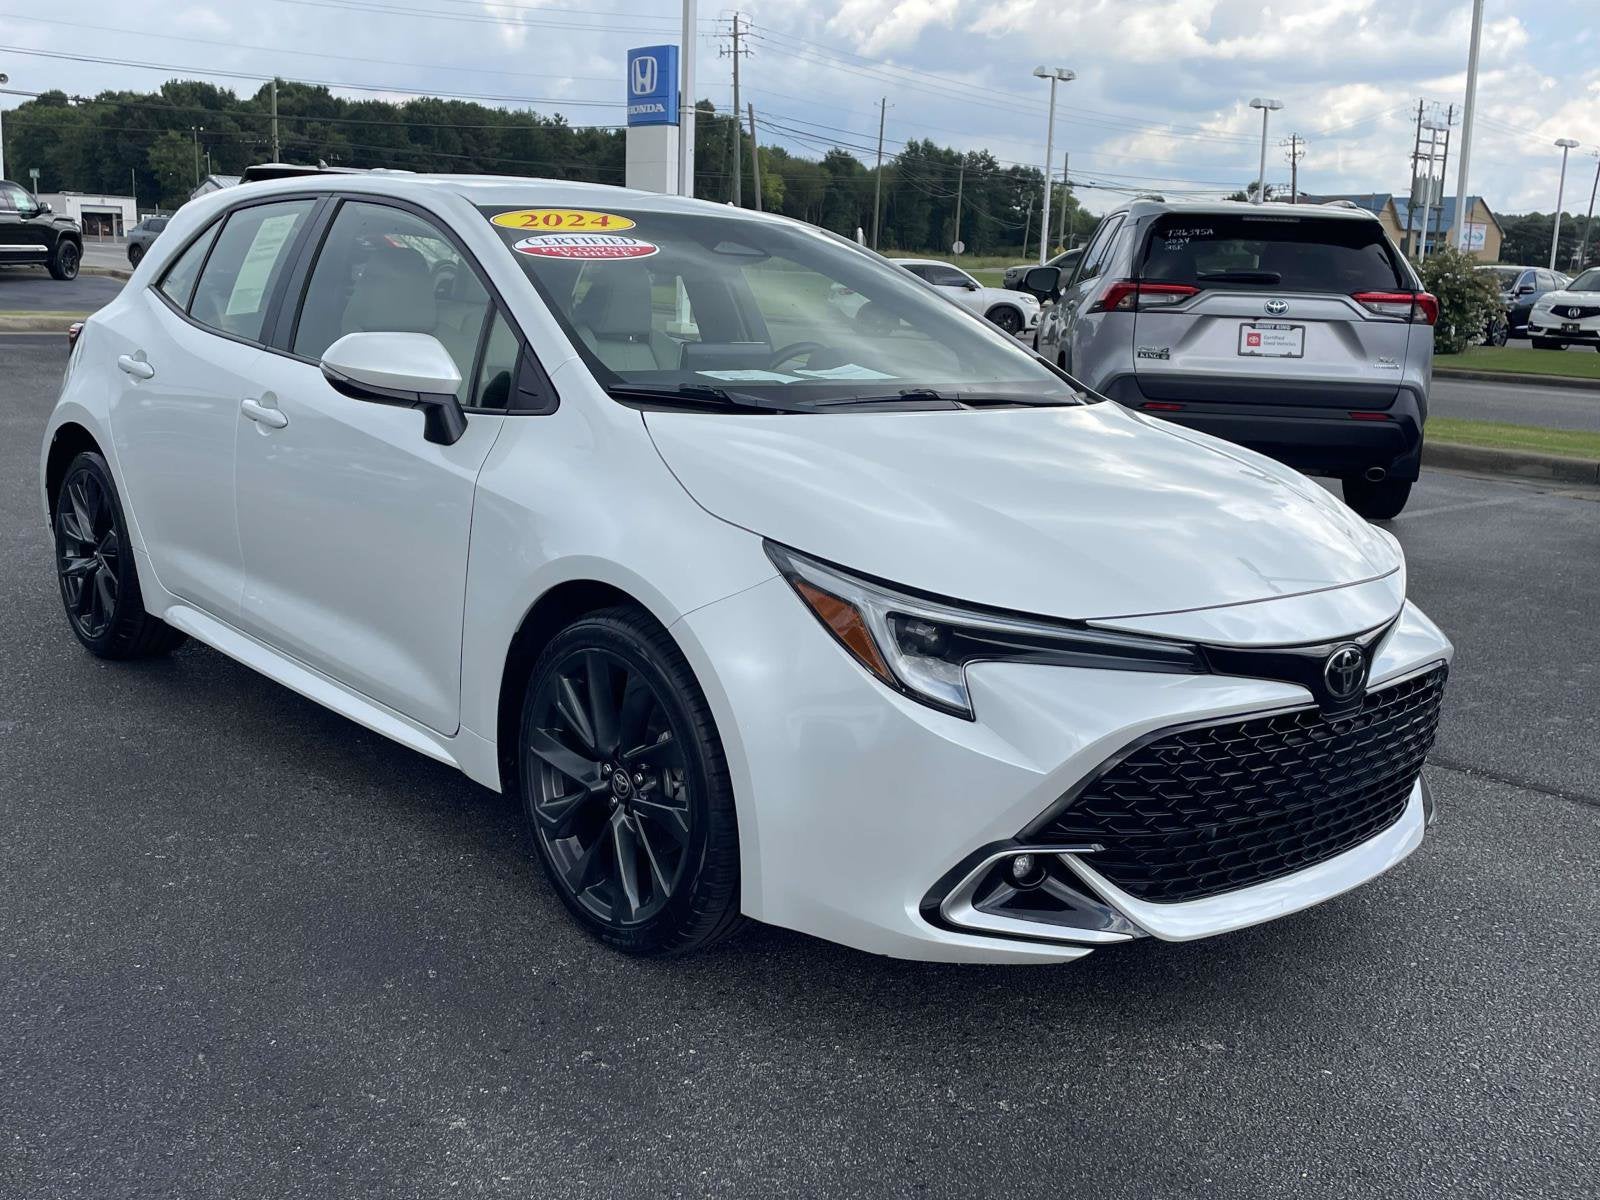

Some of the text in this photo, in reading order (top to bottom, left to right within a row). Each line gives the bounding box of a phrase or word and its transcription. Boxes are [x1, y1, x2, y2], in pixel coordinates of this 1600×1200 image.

[520, 213, 611, 228] 2024
[525, 235, 638, 247] CERTIFIED
[1139, 351, 1160, 359] KING
